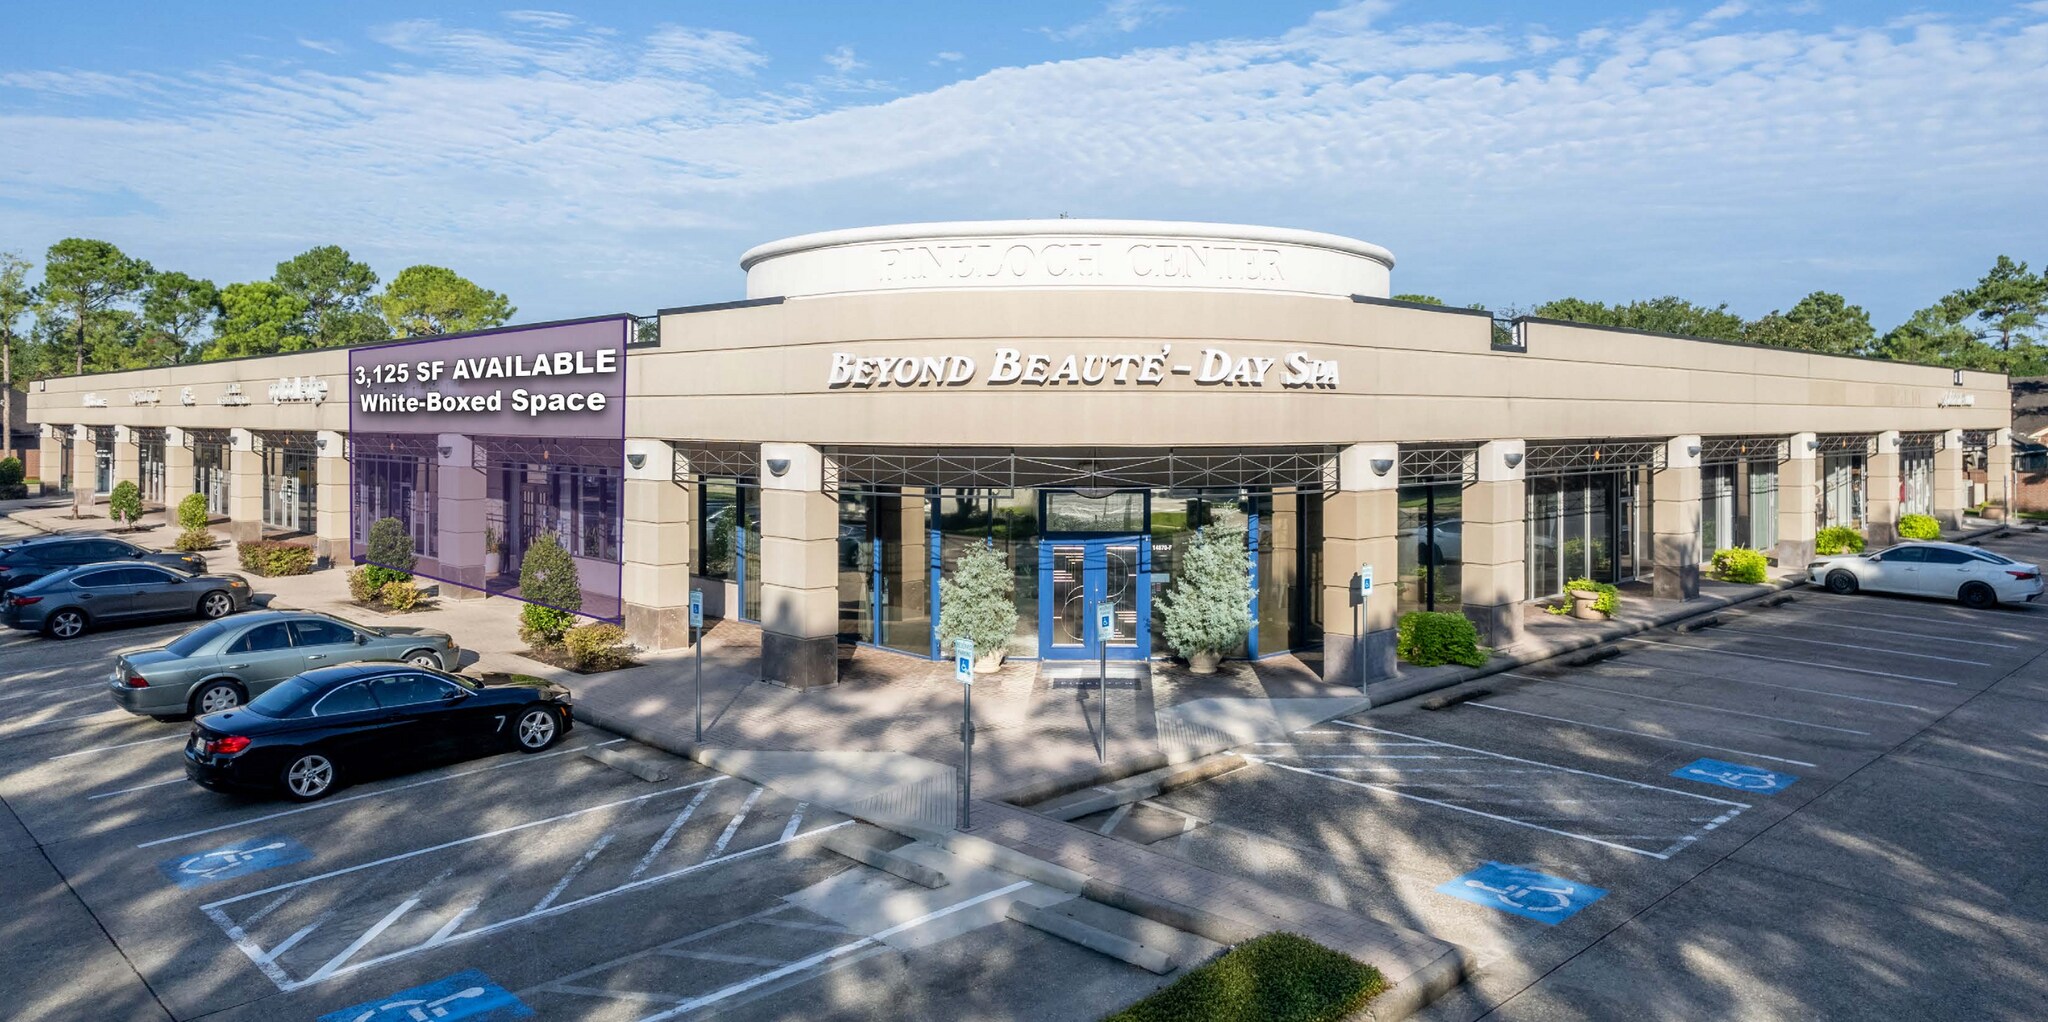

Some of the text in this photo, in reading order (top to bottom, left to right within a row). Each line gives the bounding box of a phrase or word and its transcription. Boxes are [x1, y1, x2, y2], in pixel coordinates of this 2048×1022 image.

[879, 244, 1285, 281] PINELOCH CENTER
[827, 352, 977, 389] BEYOND
[1194, 348, 1275, 387] DAY
[1279, 351, 1339, 389] SPA
